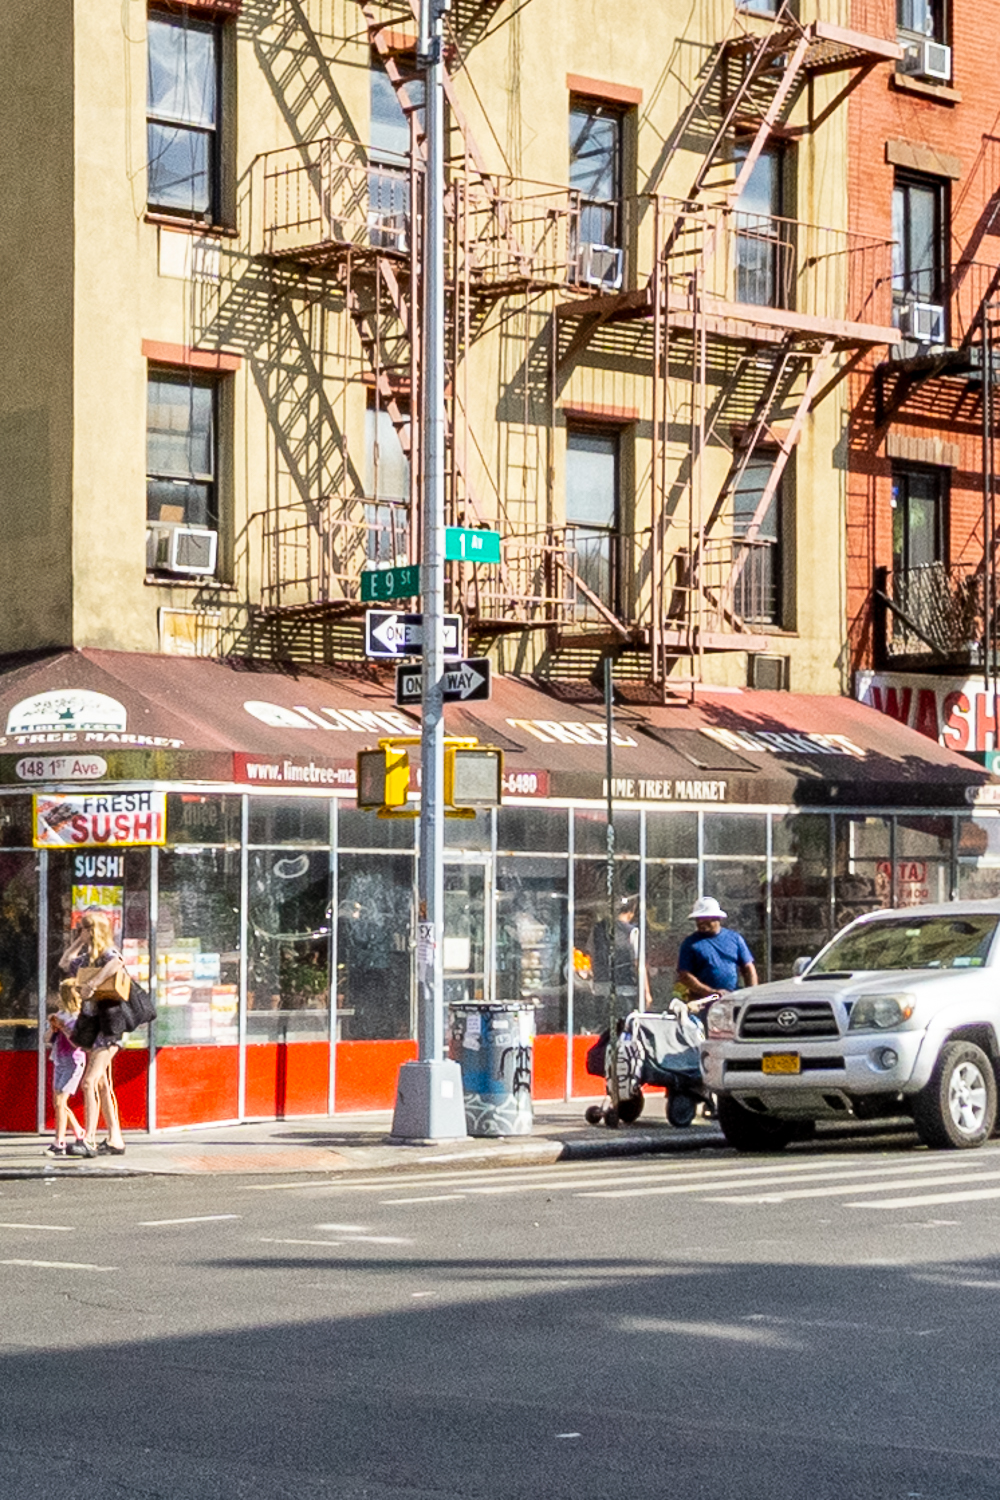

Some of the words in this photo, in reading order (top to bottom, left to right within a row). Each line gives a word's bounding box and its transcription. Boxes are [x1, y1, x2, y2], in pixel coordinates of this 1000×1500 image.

[459, 533, 466, 558] 1
[471, 534, 483, 549] Av
[371, 574, 378, 597] E
[385, 572, 394, 595] 9
[401, 570, 411, 585] St
[386, 627, 411, 642] ONE
[406, 678, 422, 693] ON
[448, 673, 474, 690] WAY
[14, 733, 77, 745] TREE
[85, 733, 184, 748] MARKET
[292, 706, 422, 735] LIME
[505, 718, 638, 747] TREE
[699, 727, 866, 756] MARKET
[20, 761, 44, 776] 148
[49, 759, 67, 776] 1ST
[246, 760, 356, 784] www.limetree-ma
[502, 774, 537, 793] -6480
[638, 780, 671, 799] TREE
[675, 780, 727, 800] MARKET
[83, 793, 151, 813] FRESH
[71, 813, 162, 843] SUSHI
[75, 855, 124, 878] SUSHI
[72, 886, 123, 906] MADE
